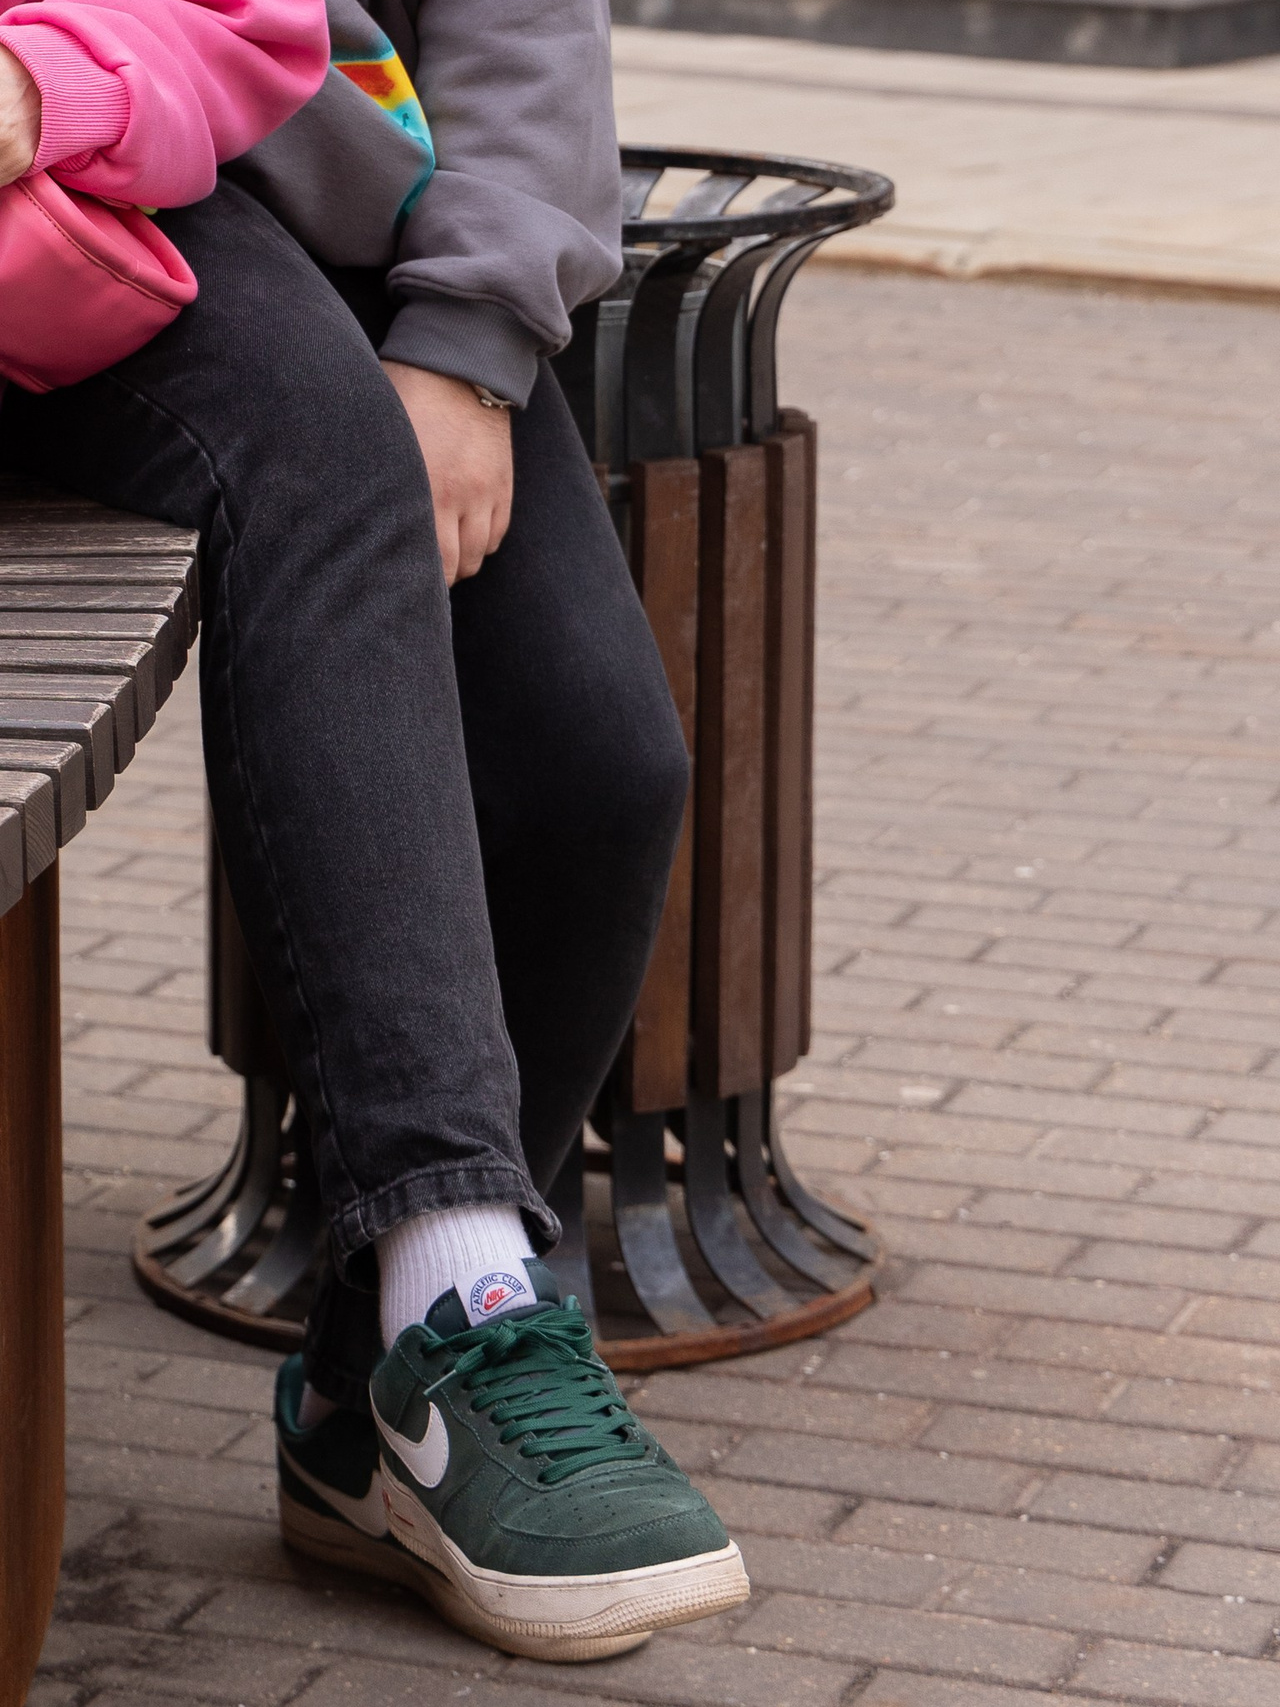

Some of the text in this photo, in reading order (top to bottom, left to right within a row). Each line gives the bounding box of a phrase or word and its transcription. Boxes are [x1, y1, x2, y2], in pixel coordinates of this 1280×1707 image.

[473, 1275, 522, 1304] ATHLETIC CLUB
[486, 1287, 505, 1303] NIKE
